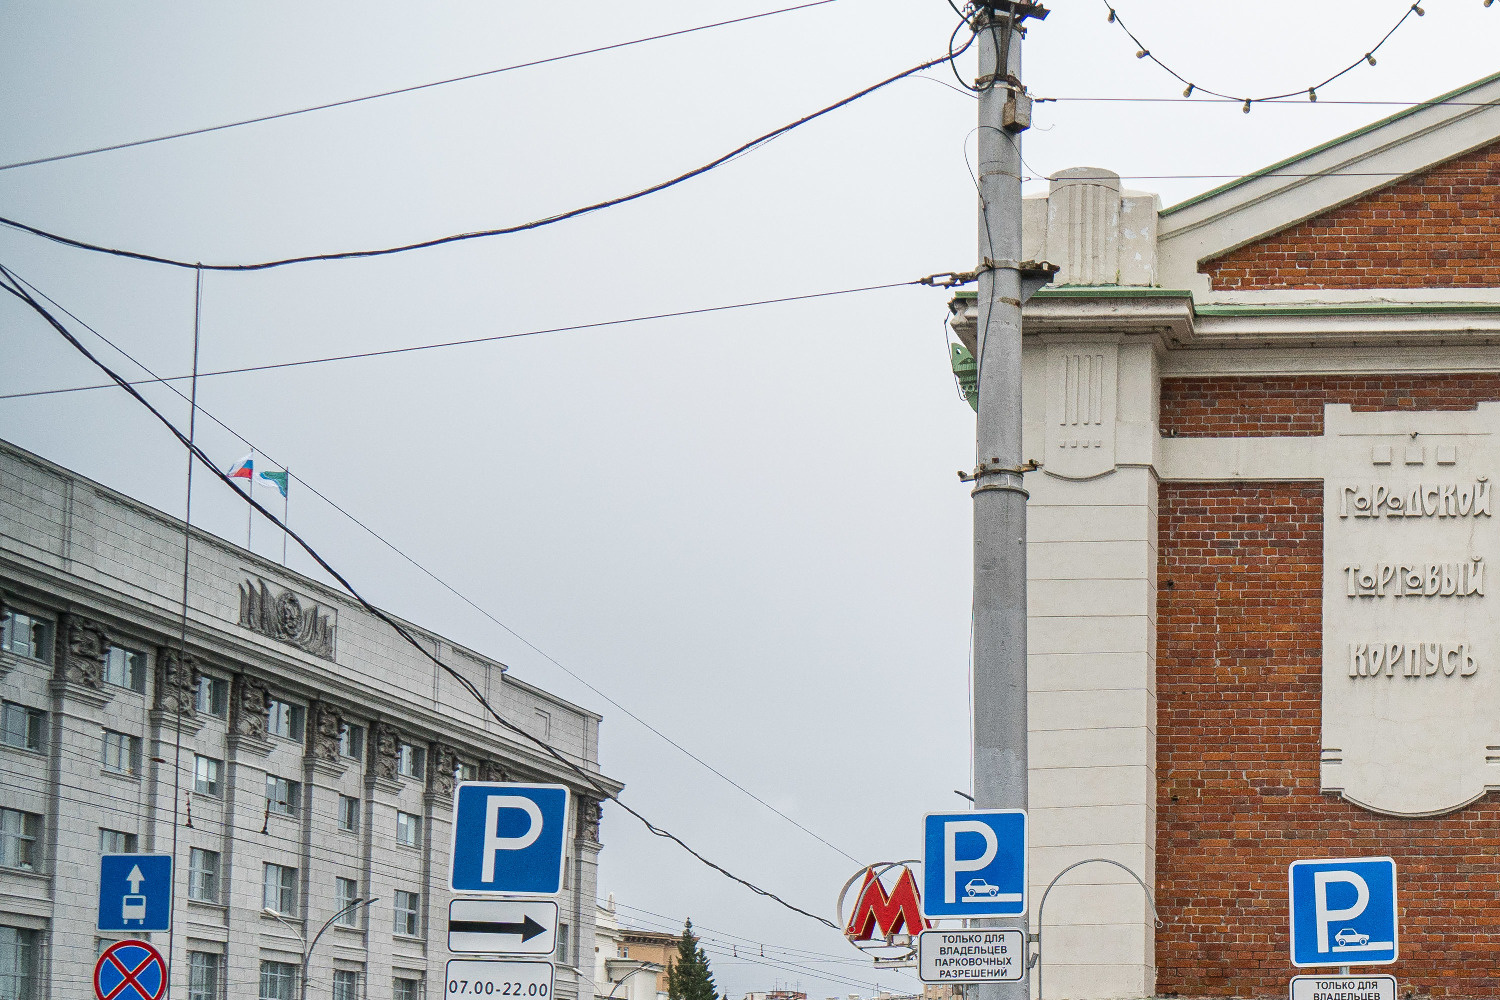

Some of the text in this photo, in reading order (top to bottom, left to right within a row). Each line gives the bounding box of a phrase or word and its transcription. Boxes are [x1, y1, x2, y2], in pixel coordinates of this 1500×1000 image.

[1339, 476, 1492, 519] ГОРОДСКОЙ
[1344, 555, 1485, 598] ТОРГОВЫЙ
[481, 794, 543, 883] P
[944, 820, 998, 904] P
[1314, 870, 1370, 953] P
[942, 935, 1005, 944] ТОЛЬКО ДЛЯ
[940, 945, 1007, 955] ВЛАДЕЛЬЦЕВ
[935, 957, 1012, 967] ПАРКОВОЧНЫХ
[939, 967, 1007, 978] РАЗРЕШЕНИЙ
[449, 980, 548, 997] 07.00-22.00
[1315, 981, 1378, 991] ТОЛЬКО ДЛЯ
